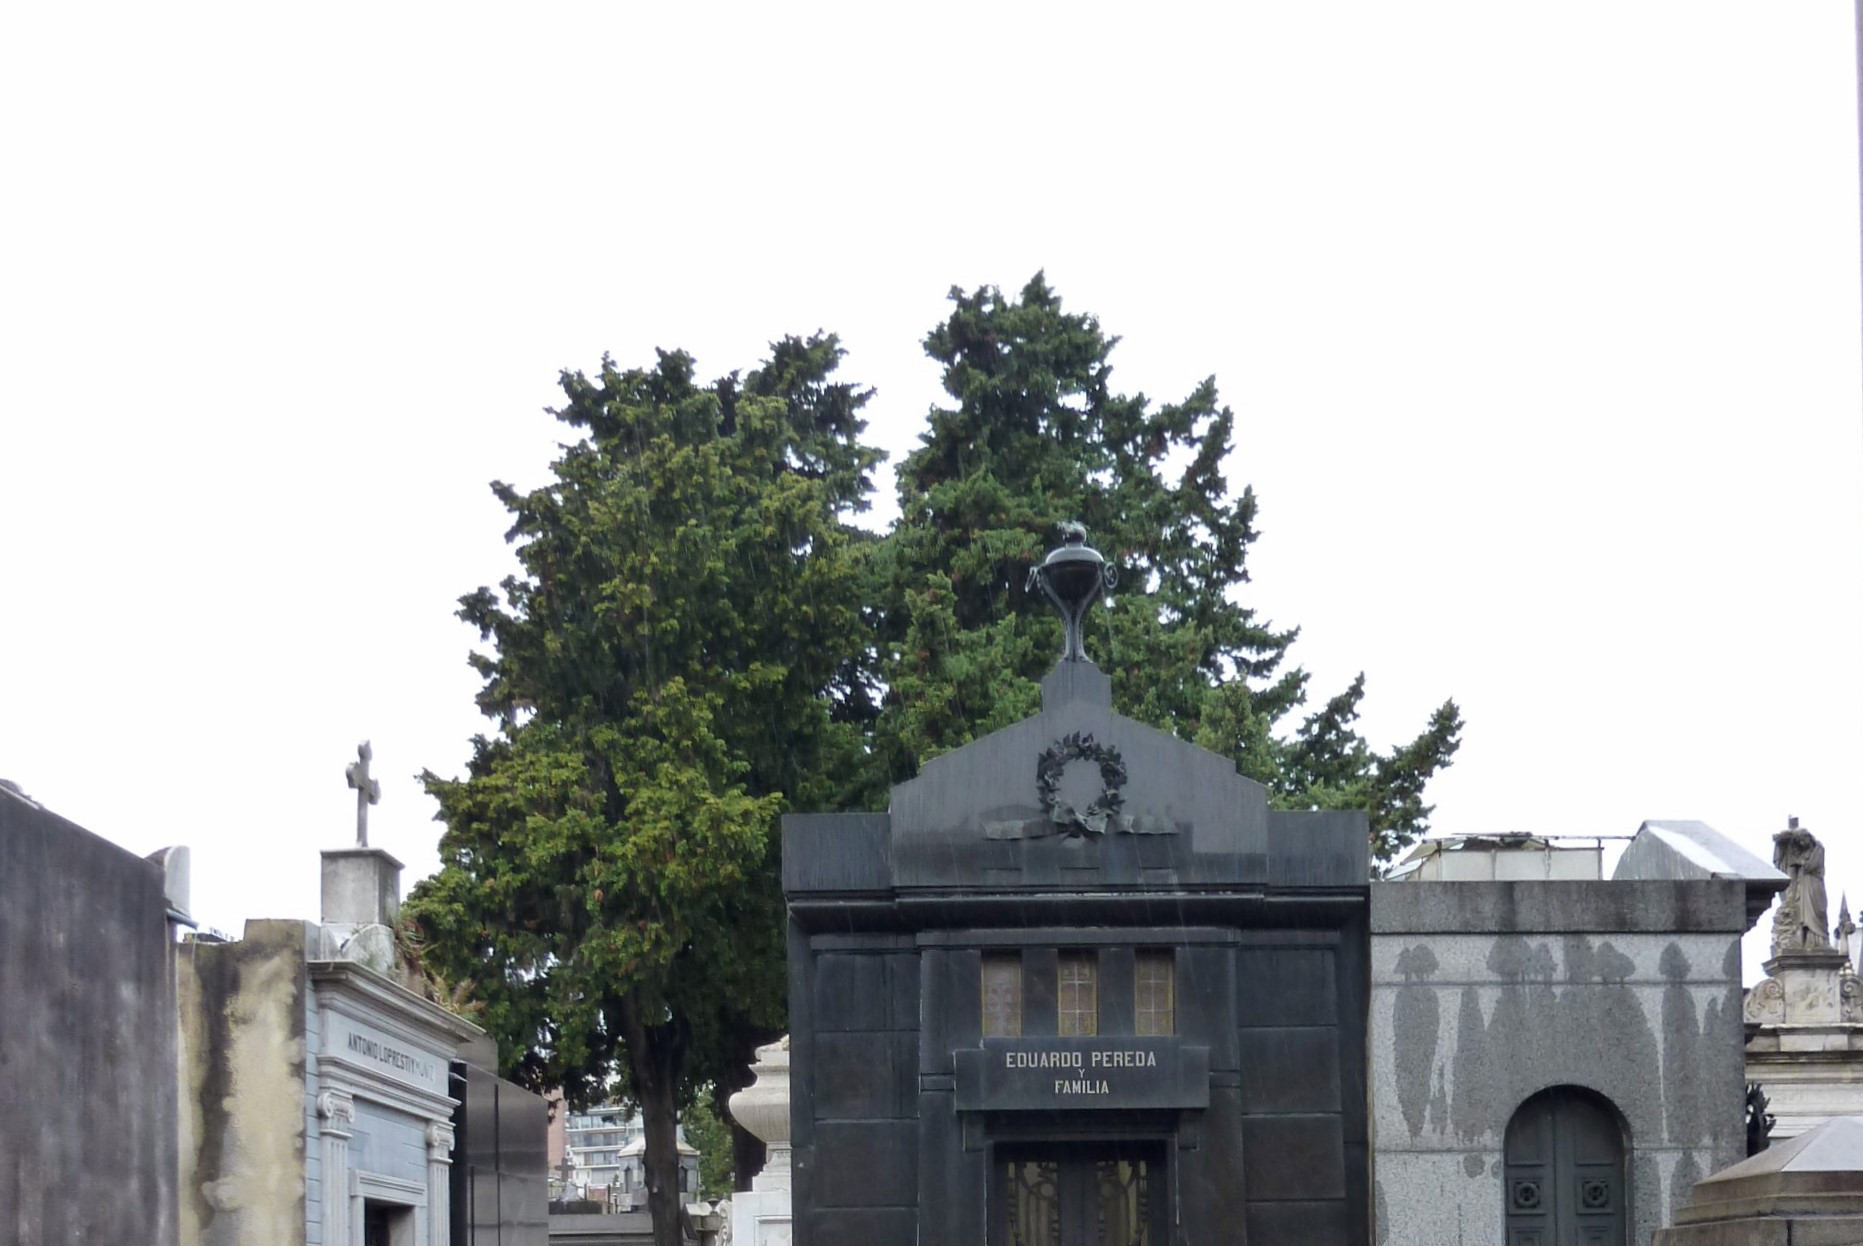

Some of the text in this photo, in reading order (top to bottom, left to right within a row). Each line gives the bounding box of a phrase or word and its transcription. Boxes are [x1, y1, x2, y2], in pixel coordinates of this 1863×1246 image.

[348, 1032, 378, 1060] ANTONIO
[1006, 1051, 1157, 1068] EDUARDO PEREDA
[1078, 1068, 1085, 1079] Y
[1055, 1080, 1109, 1094] FAMILIA
